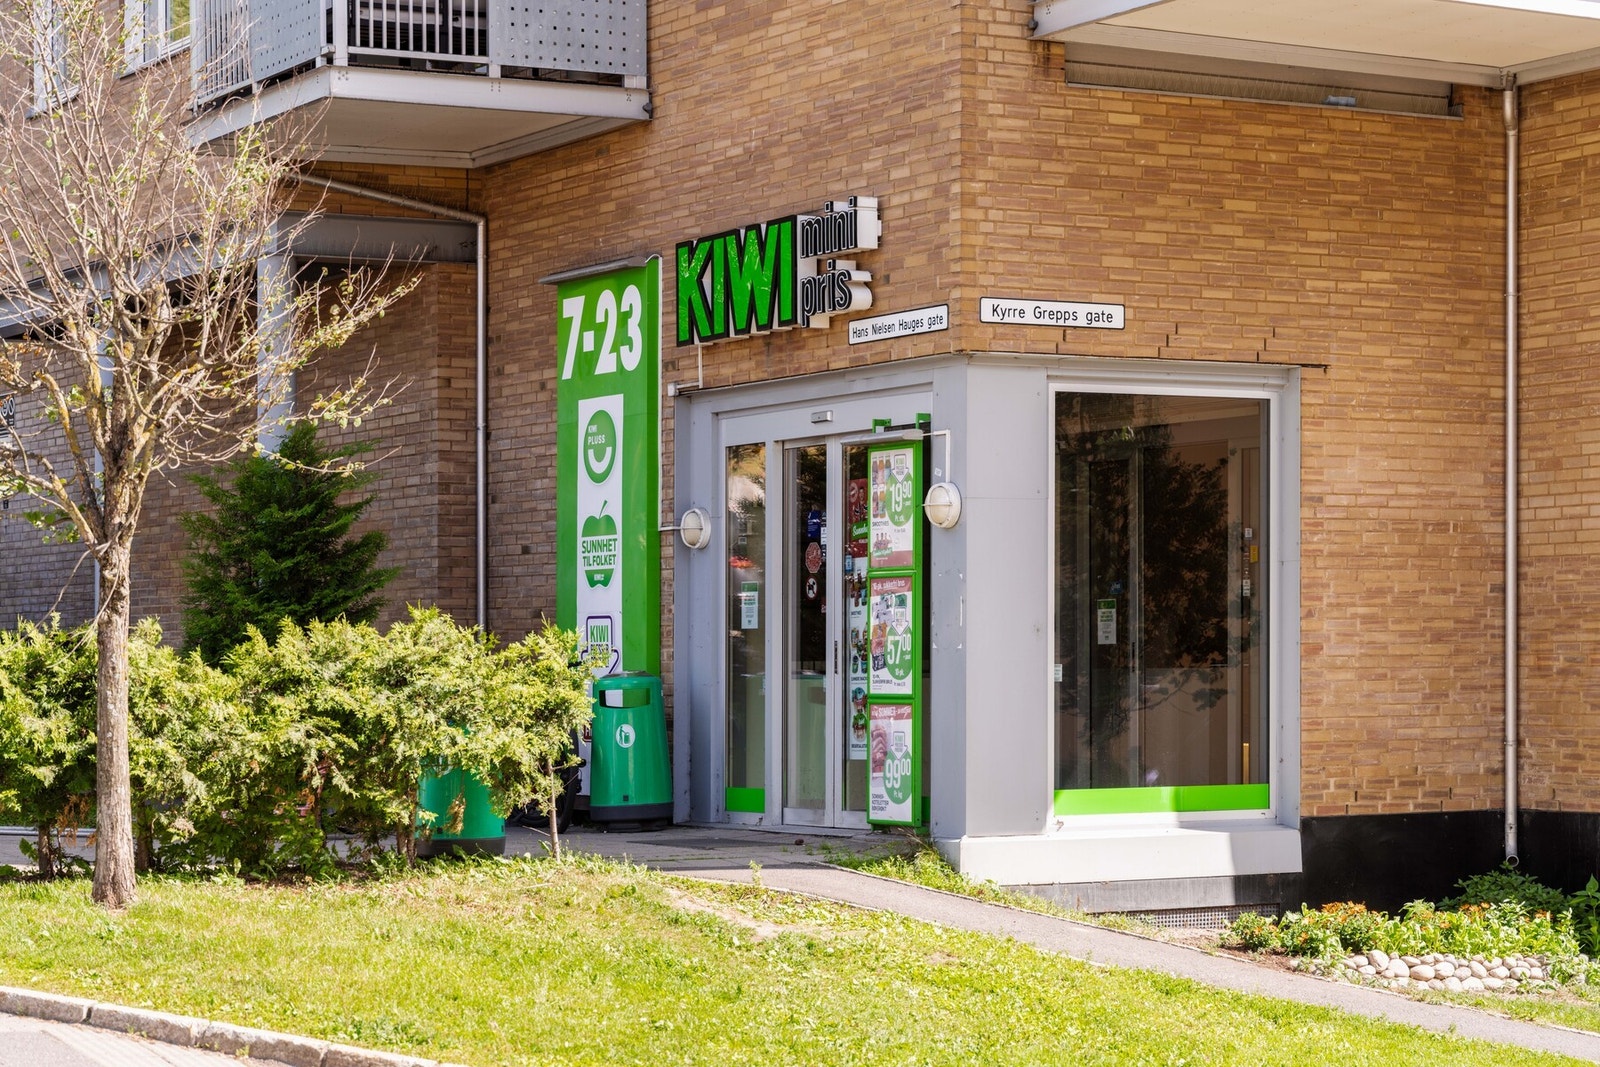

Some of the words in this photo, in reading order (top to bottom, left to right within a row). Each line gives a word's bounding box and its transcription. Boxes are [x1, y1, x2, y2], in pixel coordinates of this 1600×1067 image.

[800, 196, 857, 259] mini
[676, 214, 798, 347] KIWI
[800, 259, 852, 328] pris
[852, 326, 869, 339] Hans
[871, 322, 896, 336] Nielsen
[898, 317, 924, 332] Hauges
[927, 313, 944, 329] gate
[991, 303, 1026, 321] Kyrre
[1033, 305, 1078, 324] Grepps
[1085, 310, 1113, 325] gate
[562, 284, 643, 380] 7-23
[587, 434, 606, 446] PLUSS
[581, 537, 618, 554] SUNNHET
[582, 555, 592, 567] TIL
[592, 554, 617, 567] FOLKET
[590, 624, 609, 643] KIWI
[885, 758, 901, 789] 99
